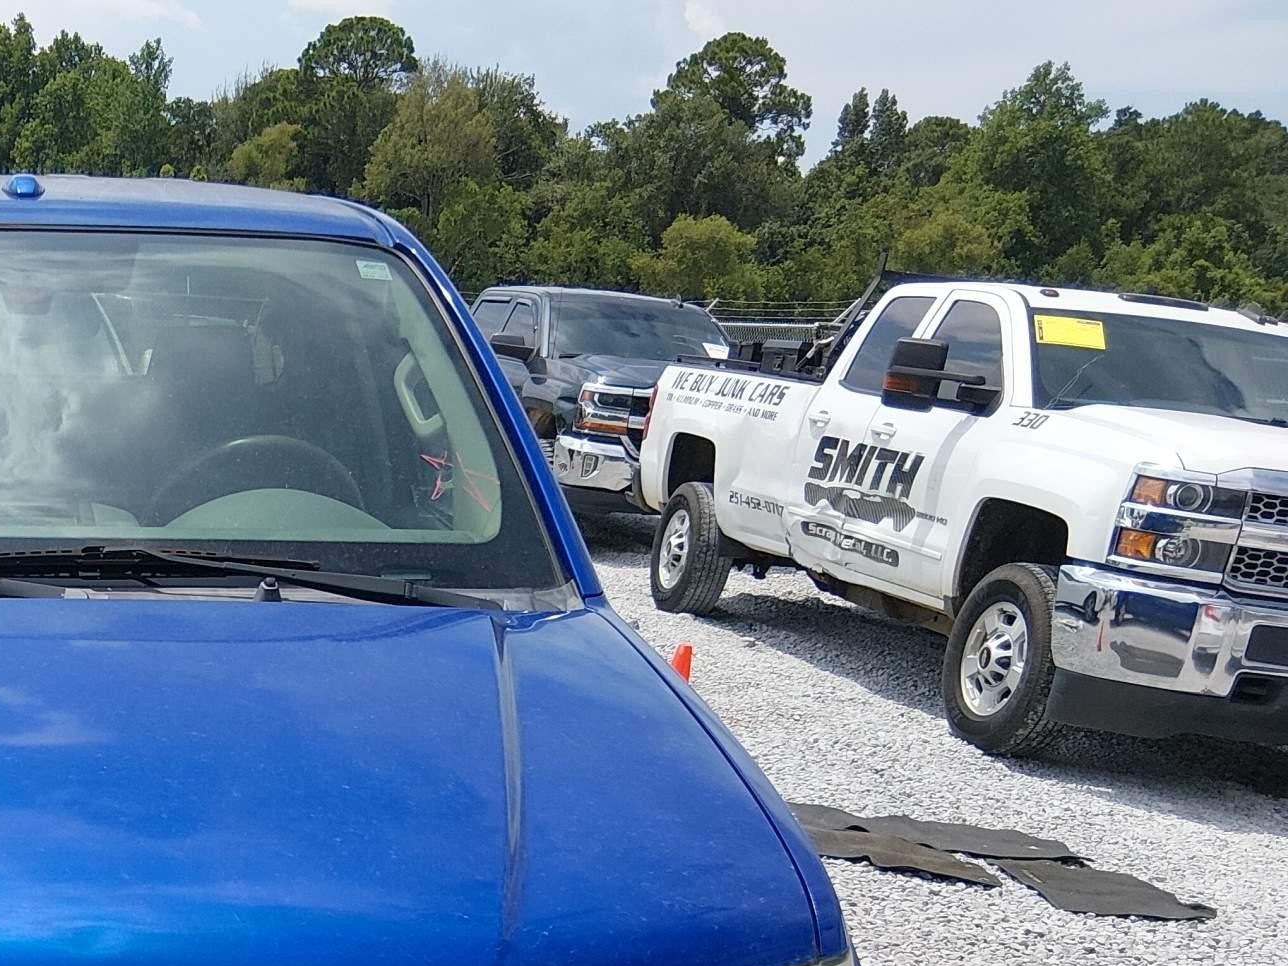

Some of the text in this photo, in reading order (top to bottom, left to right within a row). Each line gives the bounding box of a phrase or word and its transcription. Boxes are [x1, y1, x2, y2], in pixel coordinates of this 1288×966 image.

[671, 370, 791, 407] WE BUY JUNK CARS
[1011, 410, 1051, 430] 330
[807, 435, 926, 501] SMITH
